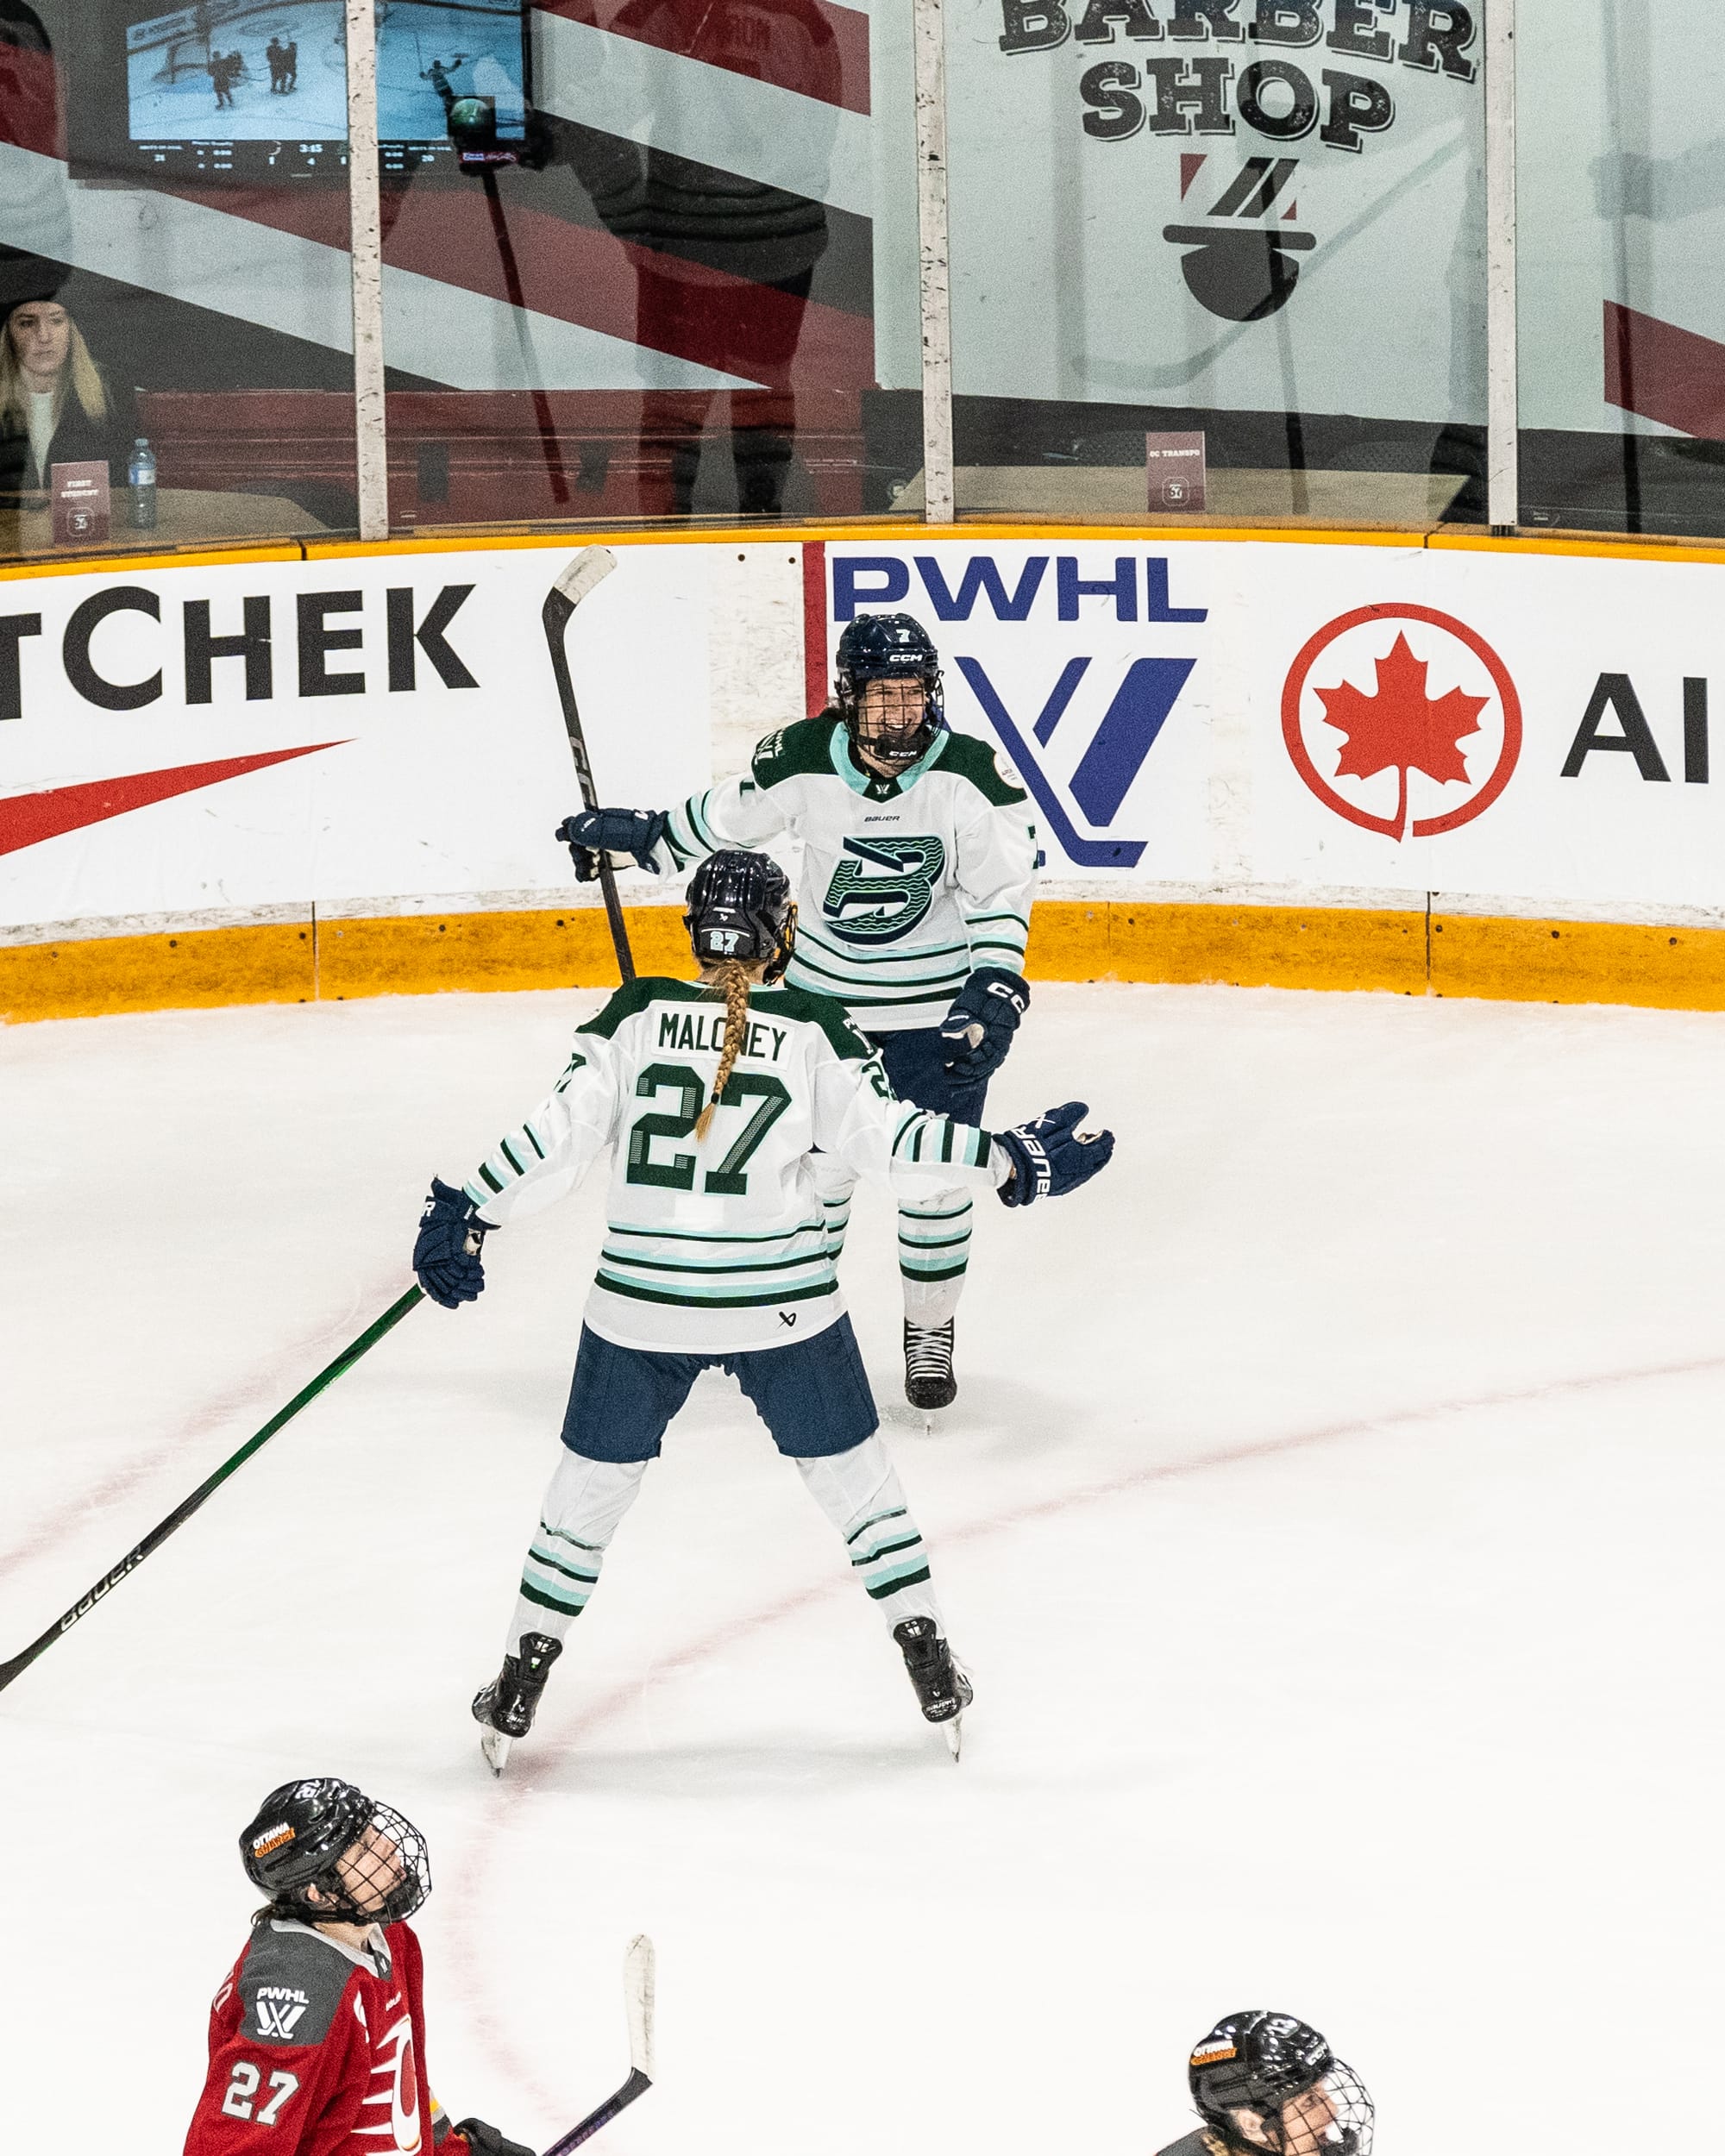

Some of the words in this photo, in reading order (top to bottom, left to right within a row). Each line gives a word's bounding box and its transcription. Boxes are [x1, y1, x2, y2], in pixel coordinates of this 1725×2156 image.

[1081, 58, 1396, 154] SHOP
[832, 556, 1208, 623] PWHL
[889, 653, 923, 662] CCM
[895, 629, 911, 642] 7
[1559, 673, 1709, 785] AI
[710, 931, 740, 953] 27
[625, 1062, 793, 1197] 27
[253, 1821, 291, 1850] OTTAWA
[257, 1987, 310, 2004] PWHL
[222, 2061, 300, 2126] 27
